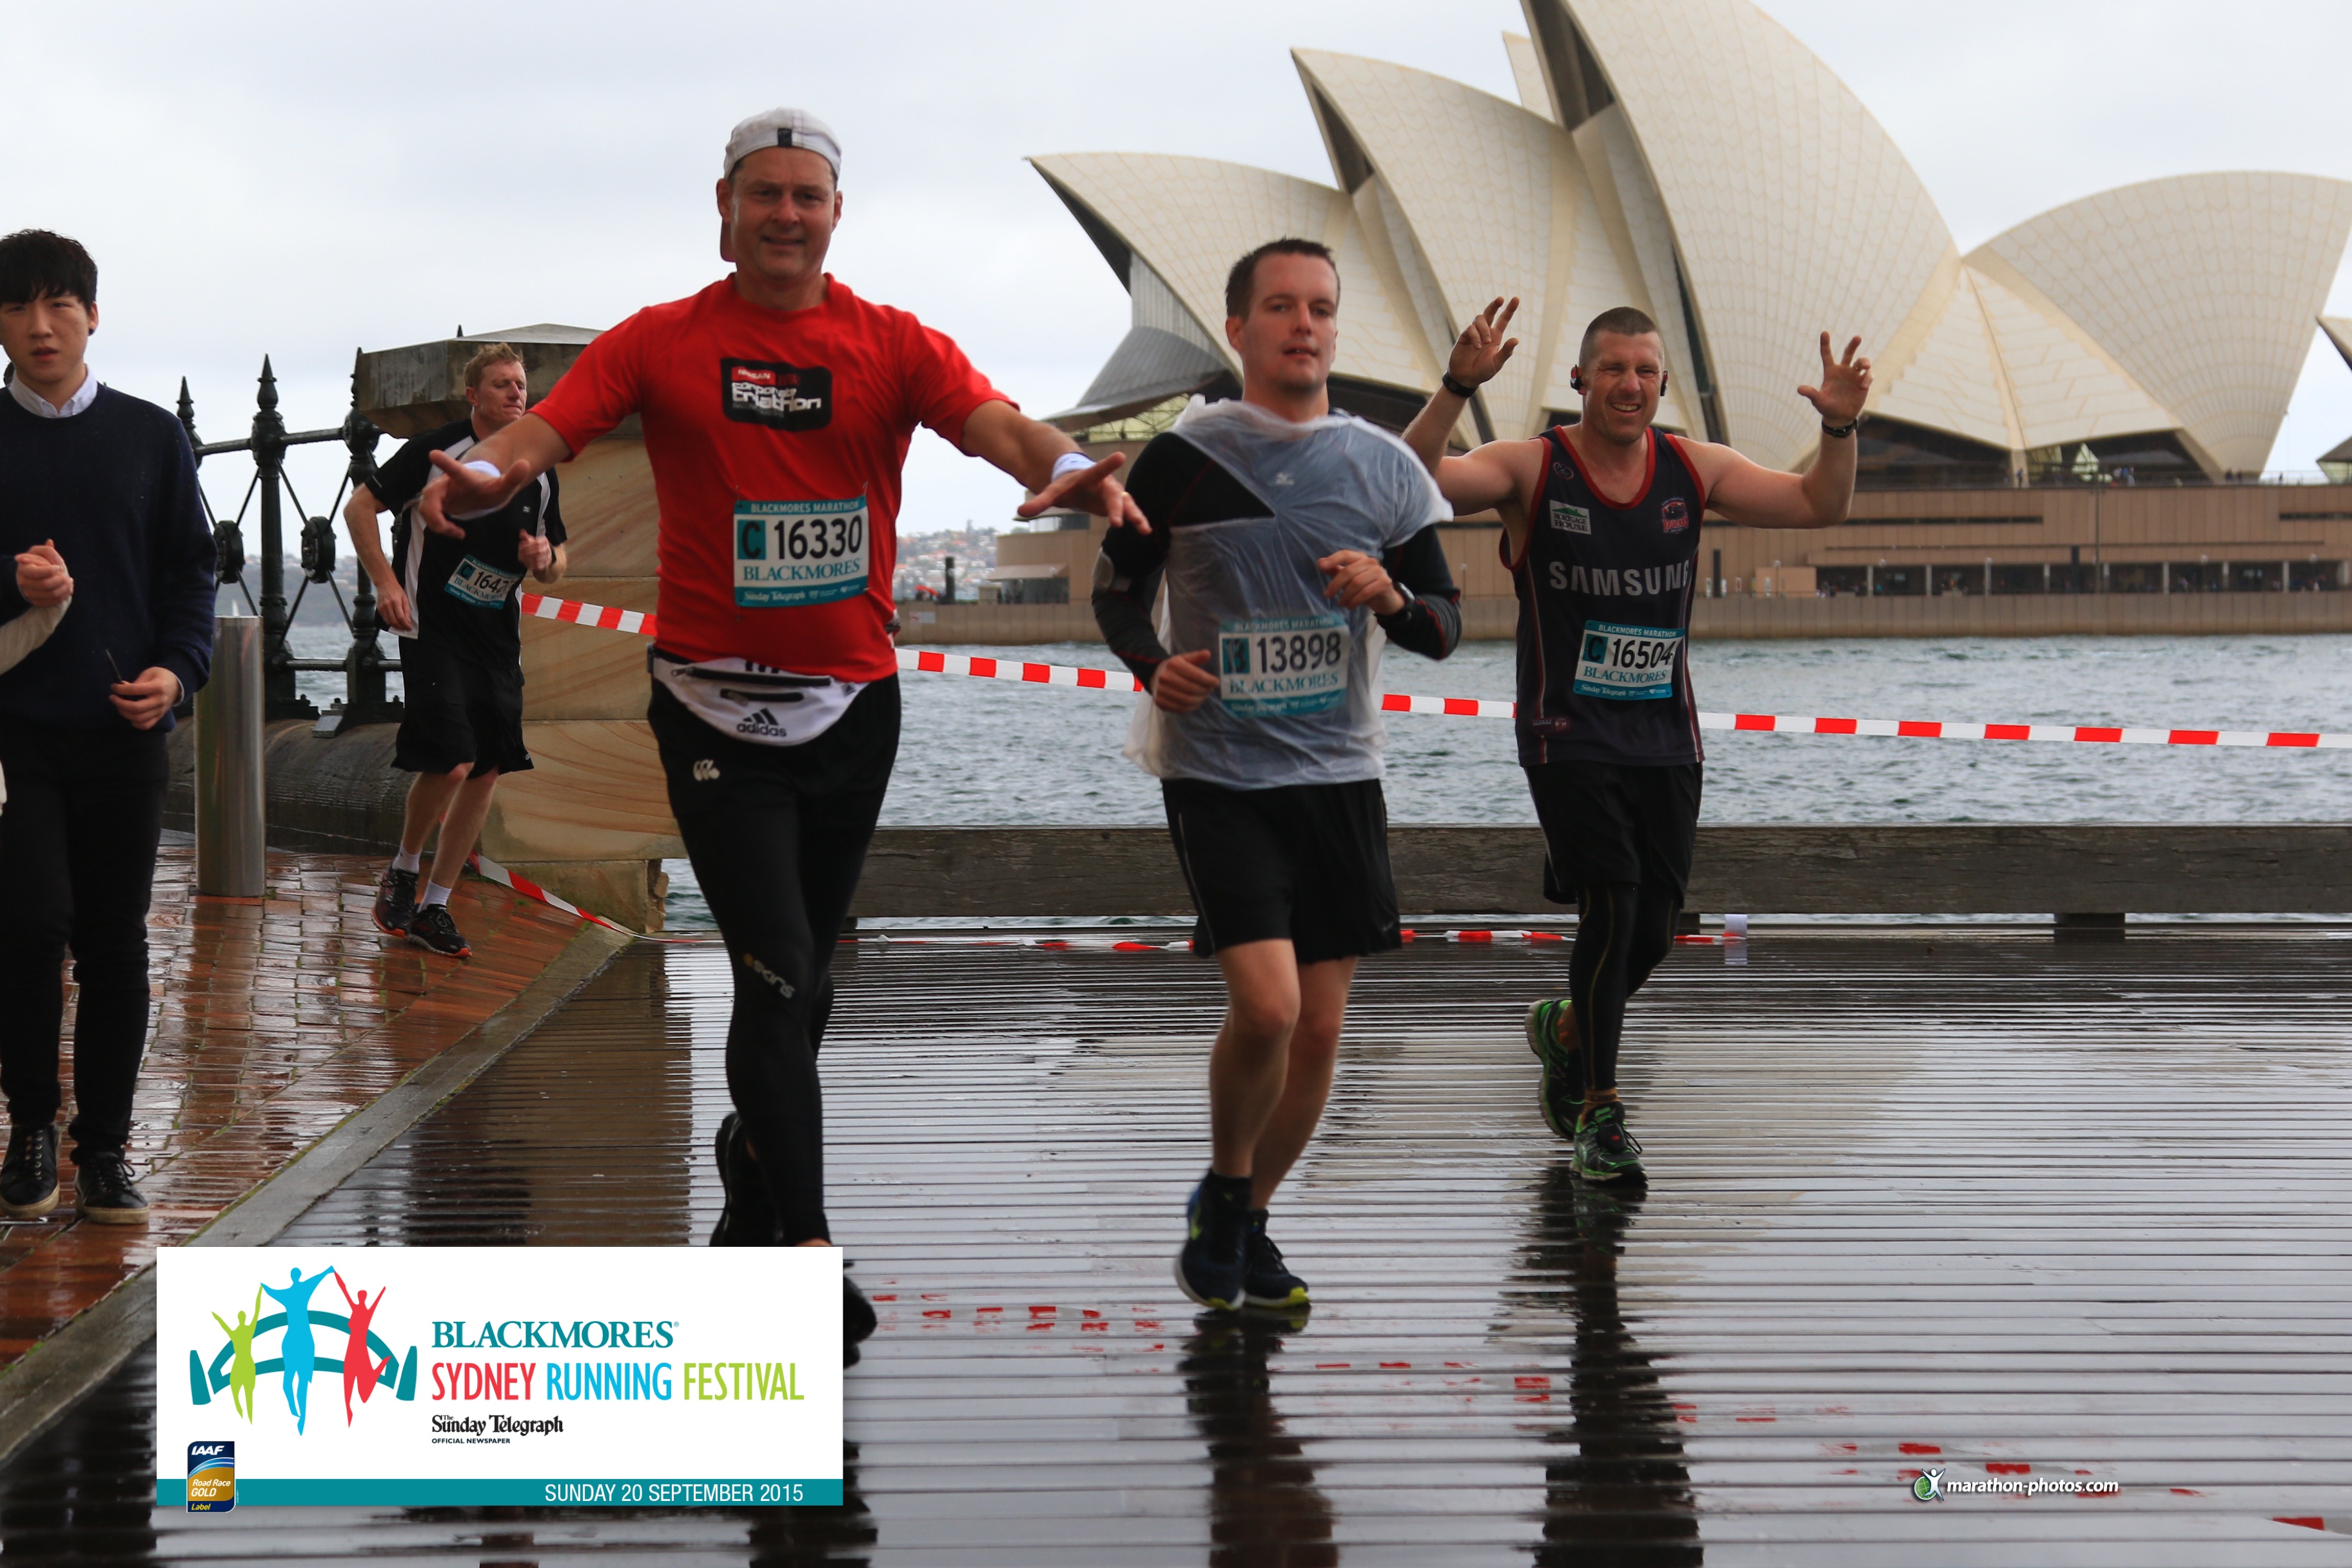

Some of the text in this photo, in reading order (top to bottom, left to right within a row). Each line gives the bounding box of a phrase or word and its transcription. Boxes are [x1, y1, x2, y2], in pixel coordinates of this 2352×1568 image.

[751, 500, 859, 513] BLACKMORES MARATHON
[1554, 512, 1587, 525] MORTGAGE
[1554, 519, 1588, 532] HOUSE
[742, 514, 862, 560] C 16330
[462, 564, 473, 578] C
[743, 560, 860, 581] BLACKMORES
[1235, 620, 1289, 631] BLAKMORES
[1598, 624, 1677, 638] BLACKMORES MARATHON
[1257, 631, 1342, 674] 13898
[1588, 636, 1676, 669] C 16504
[1583, 665, 1667, 683] BLACKMORES
[1582, 683, 1601, 694] Sunday
[736, 722, 787, 737] adidas
